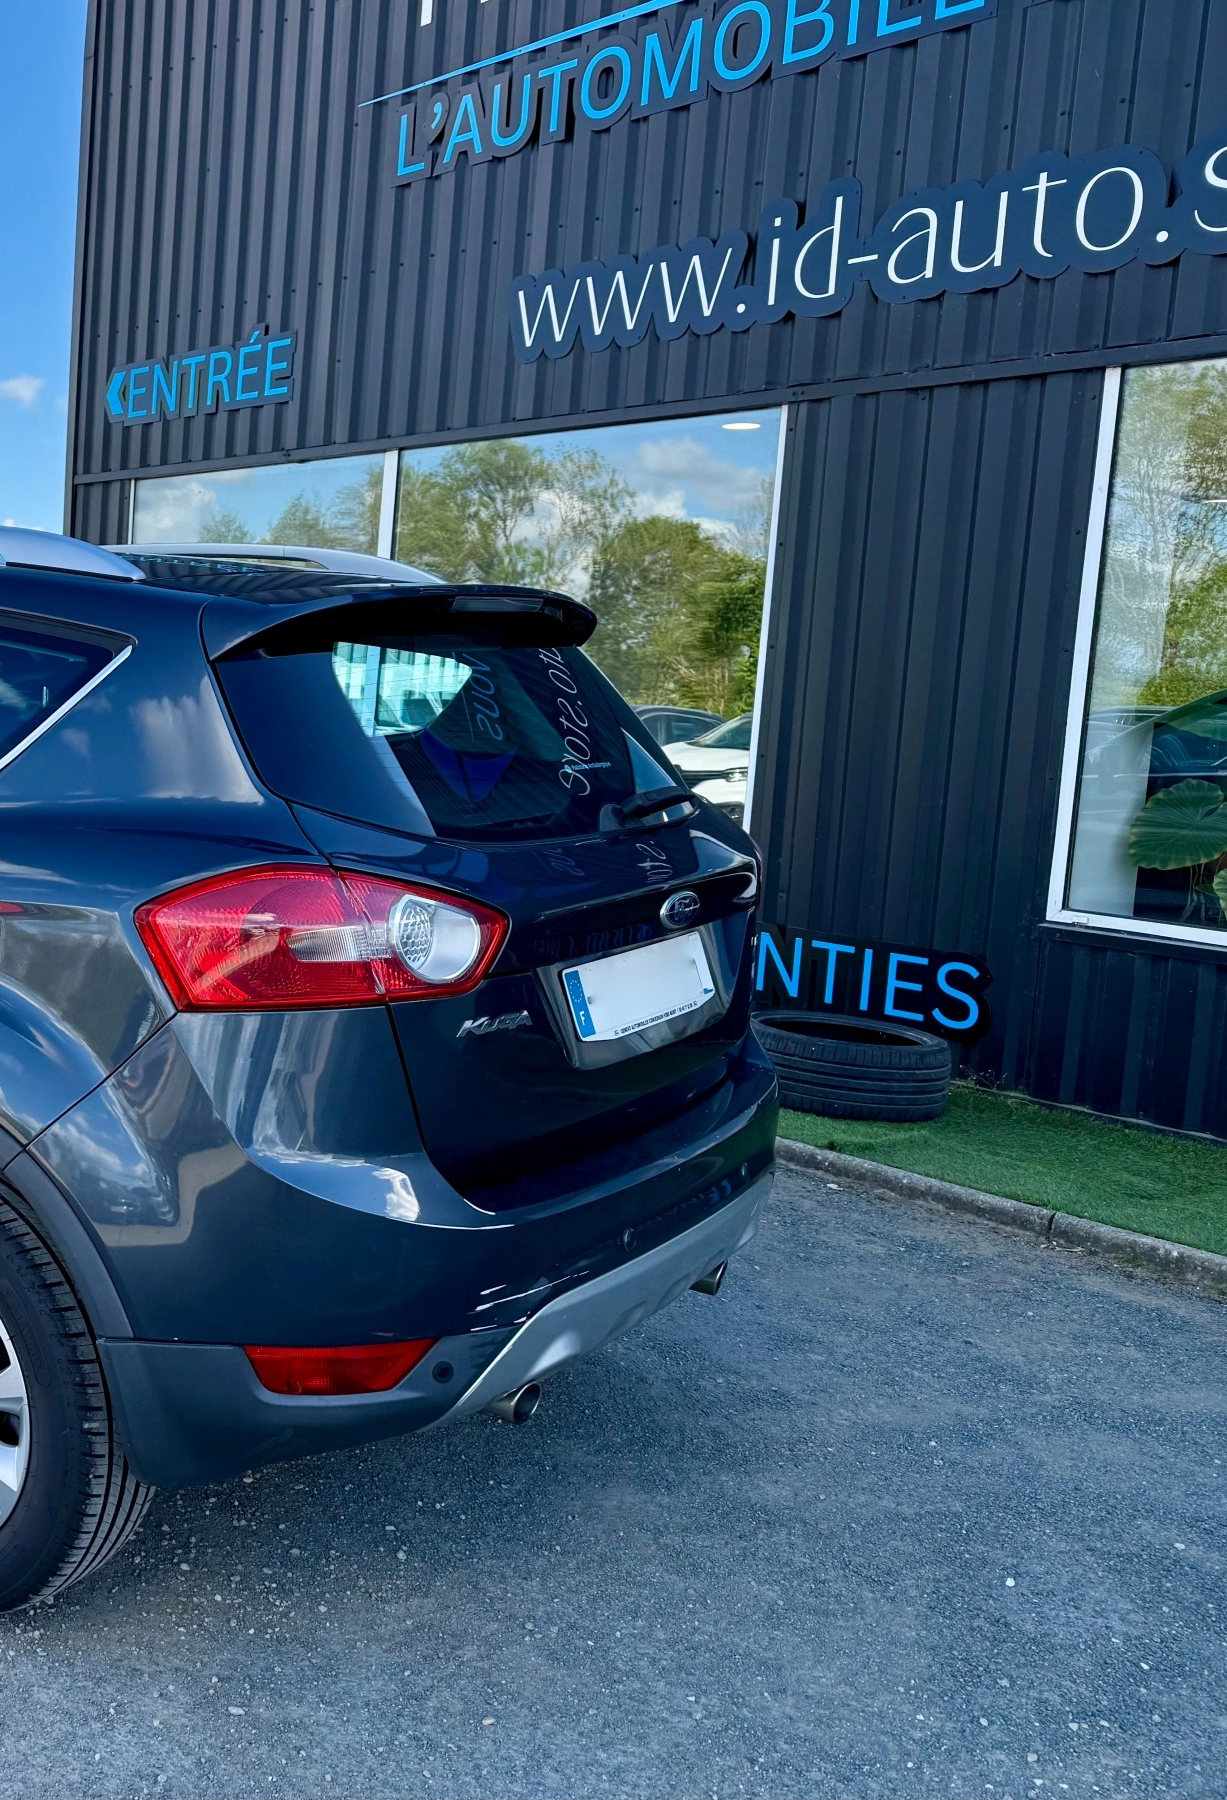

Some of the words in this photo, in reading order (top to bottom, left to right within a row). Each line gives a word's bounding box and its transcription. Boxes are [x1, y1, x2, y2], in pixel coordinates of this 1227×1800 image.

[397, 0, 985, 177] L'AUTOMOBIL
[127, 330, 292, 419] ENTRÉE
[579, 1010, 586, 1026] F
